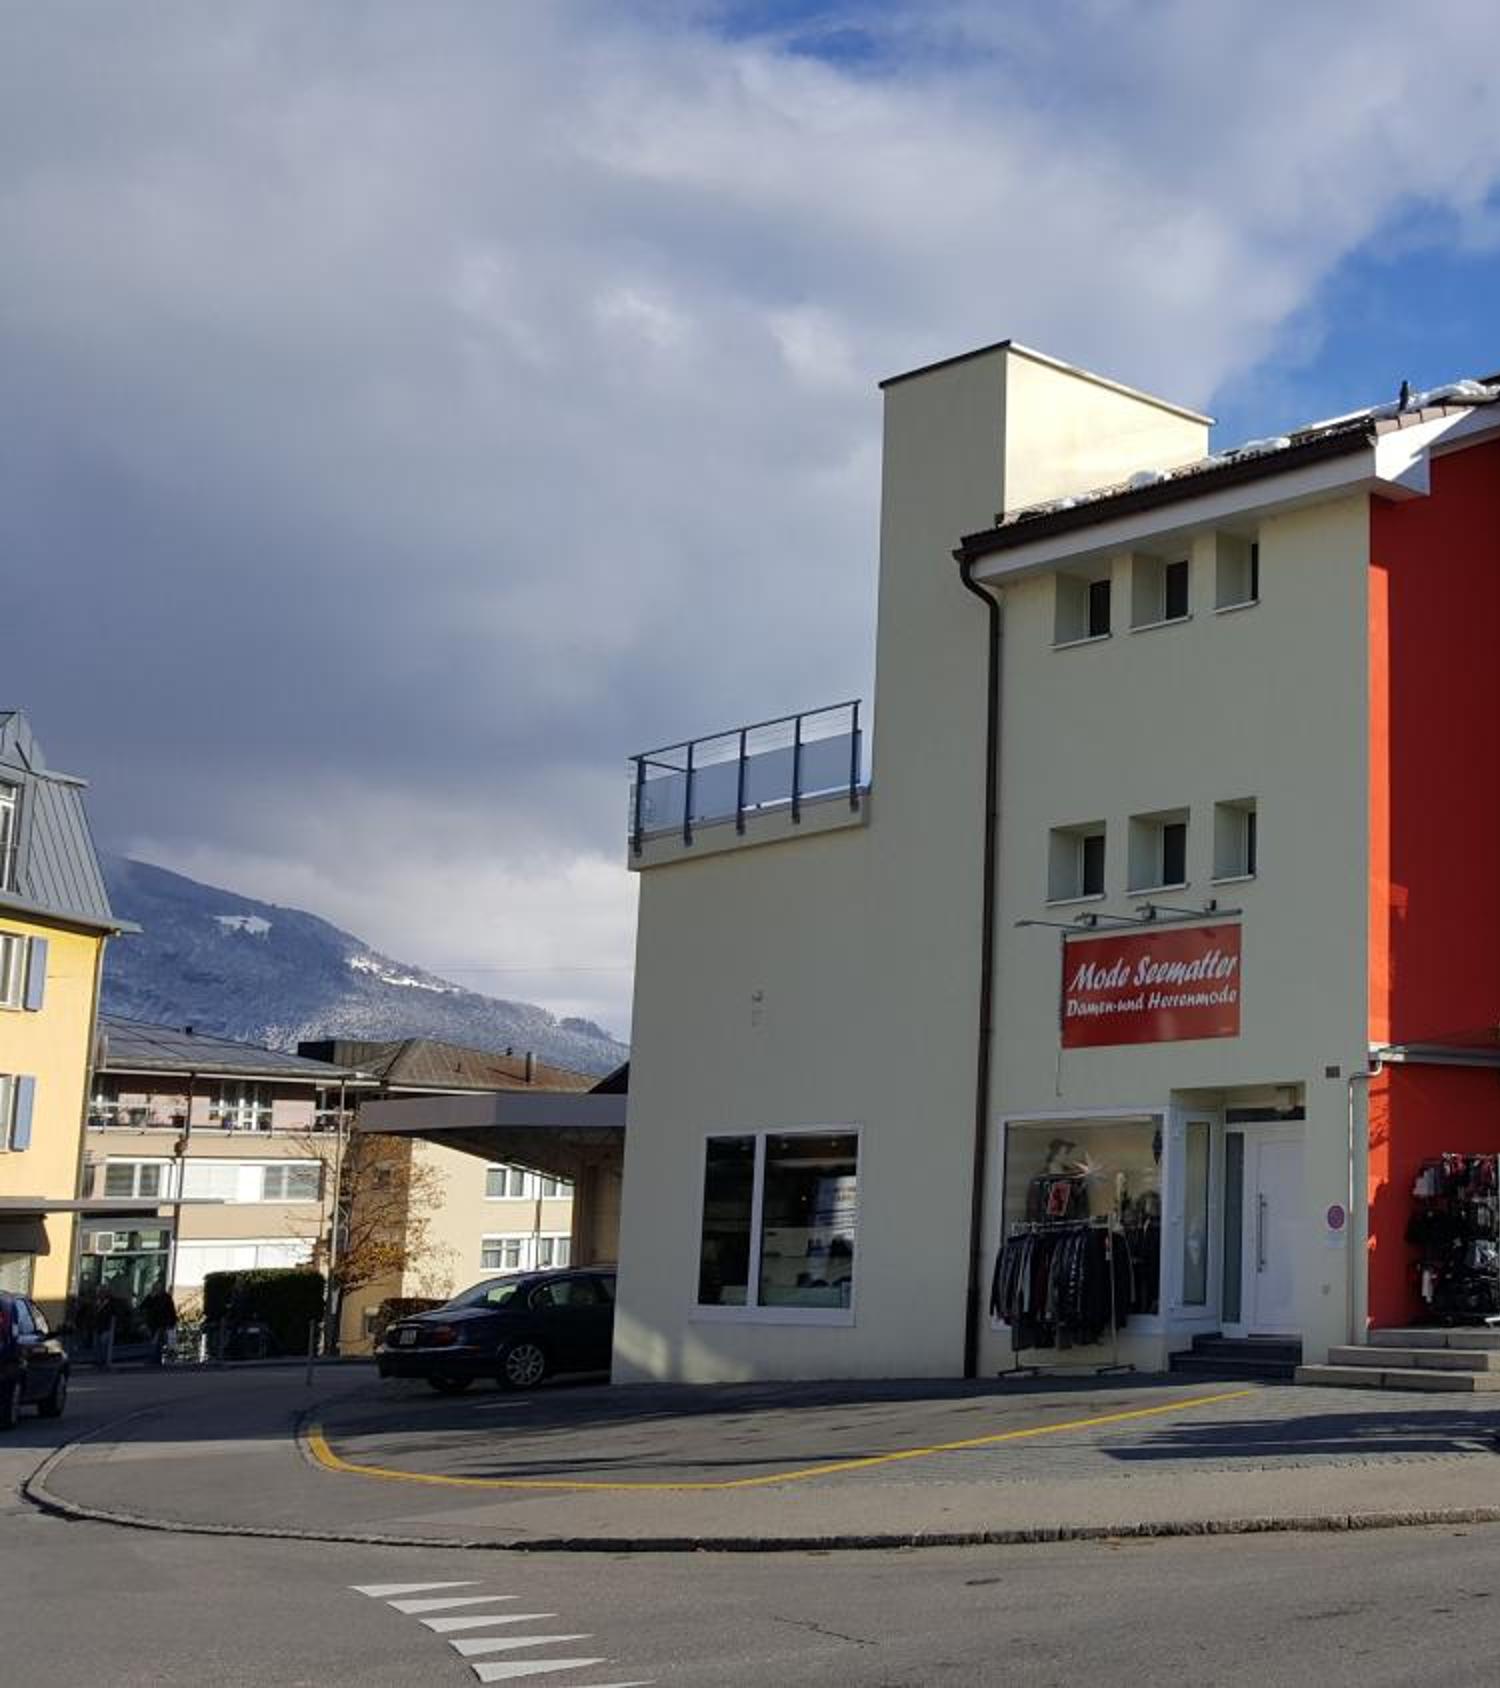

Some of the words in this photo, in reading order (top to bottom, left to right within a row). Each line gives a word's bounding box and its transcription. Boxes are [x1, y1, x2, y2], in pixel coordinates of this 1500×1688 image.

[1068, 957, 1131, 992] Mode
[1133, 950, 1237, 985] Seematter
[1148, 984, 1237, 1009] Herrenmode
